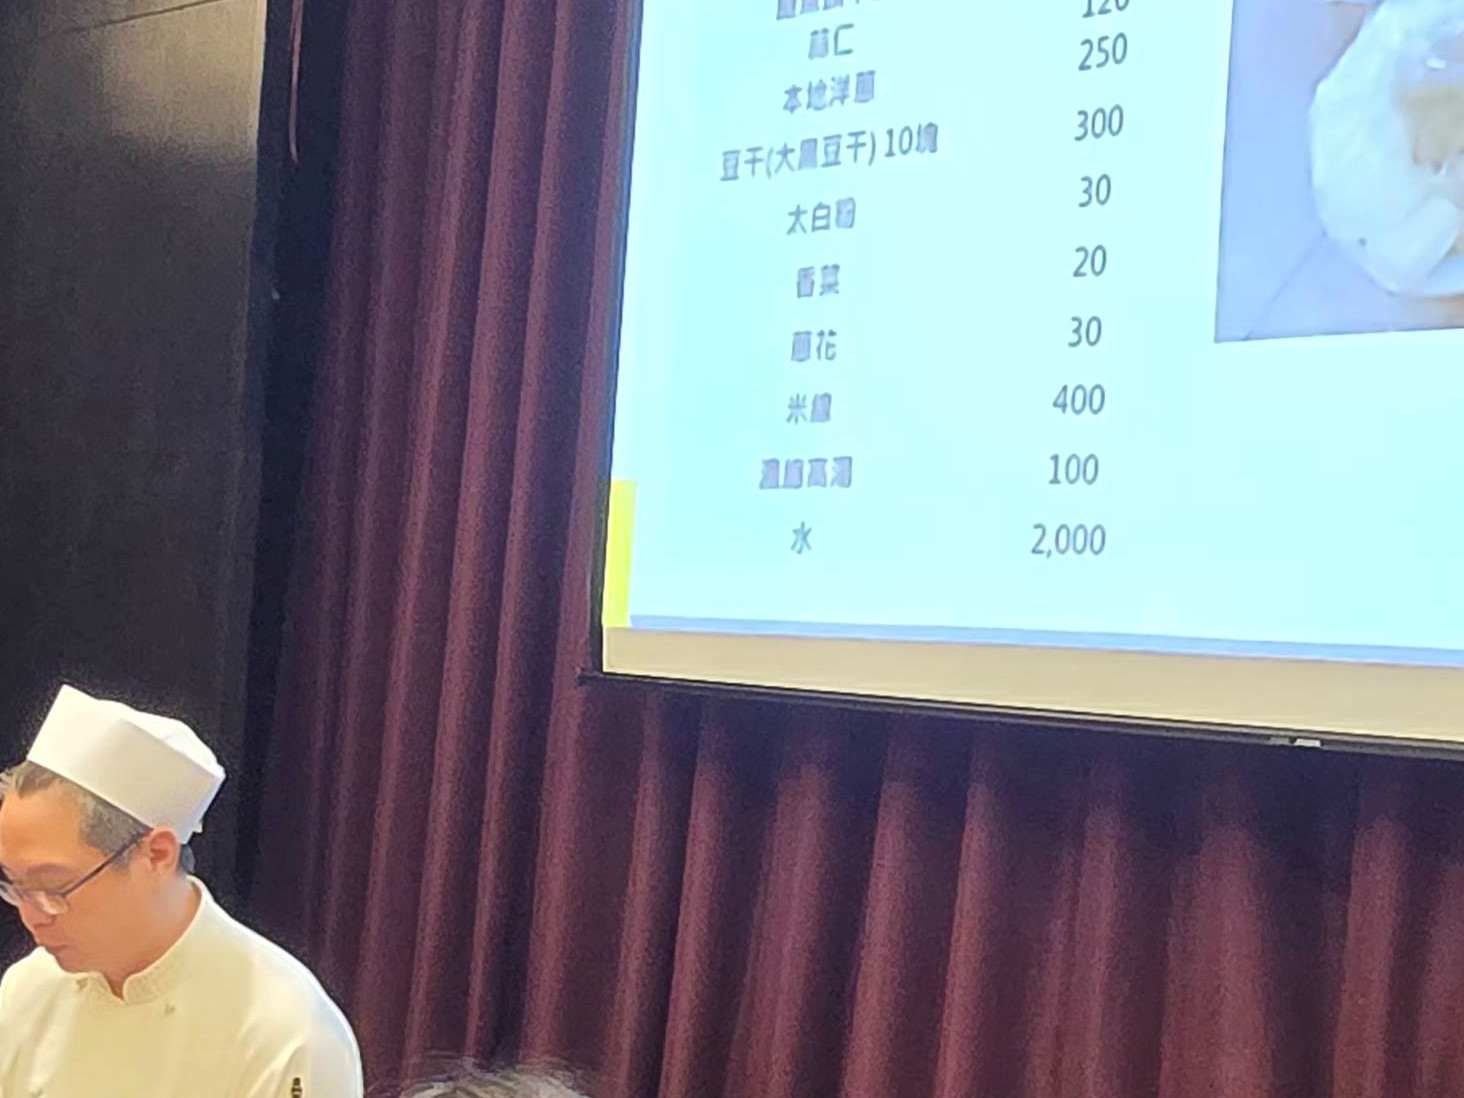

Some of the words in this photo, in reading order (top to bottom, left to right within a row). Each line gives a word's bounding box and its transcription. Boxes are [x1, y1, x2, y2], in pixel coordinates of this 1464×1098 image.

[1078, 31, 1128, 71] 250
[1074, 104, 1124, 141] 300
[1078, 173, 1112, 208] 30
[1072, 244, 1108, 278] 20
[1067, 315, 1103, 347] 30
[1052, 383, 1106, 415] 400
[1048, 453, 1099, 486] 100
[790, 520, 813, 554] 水
[1030, 523, 1107, 559] 2,000
